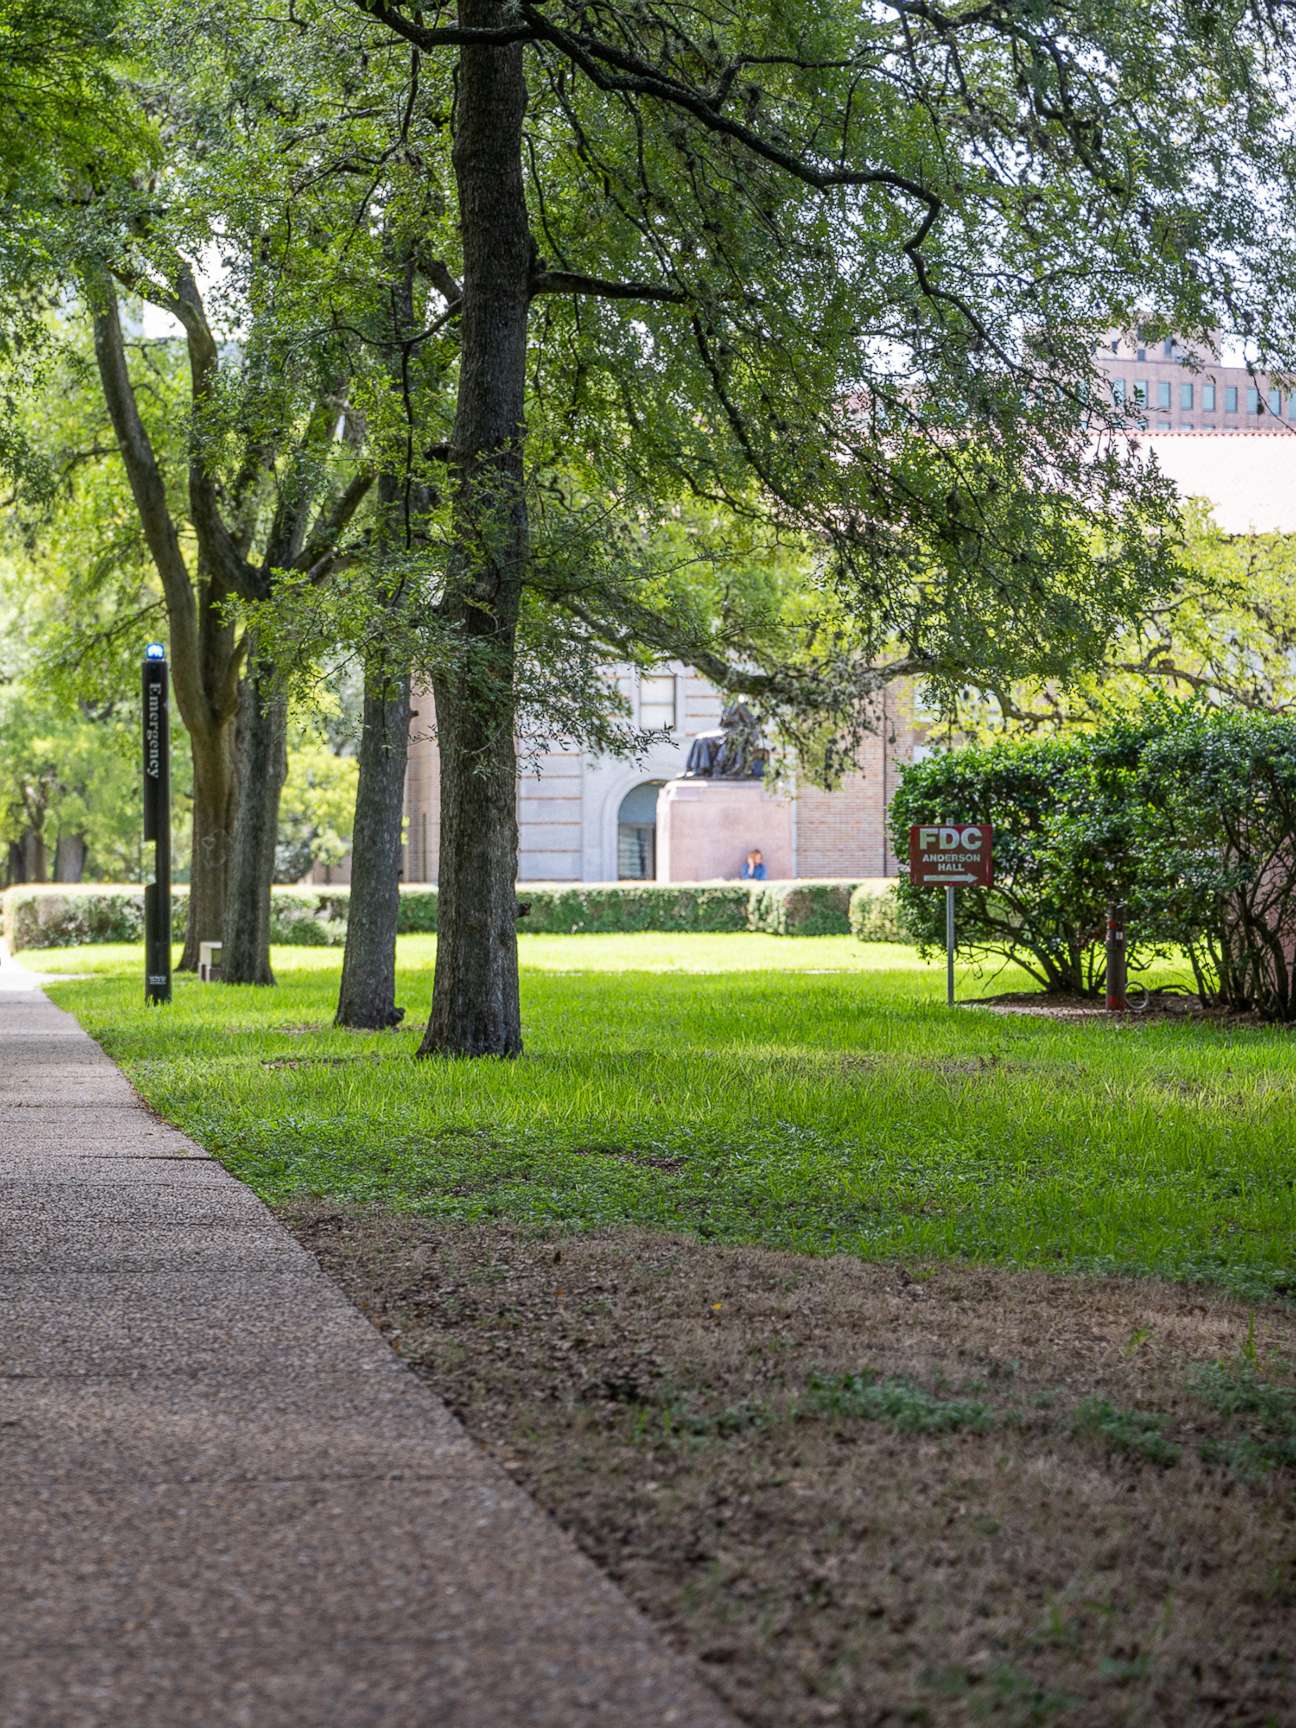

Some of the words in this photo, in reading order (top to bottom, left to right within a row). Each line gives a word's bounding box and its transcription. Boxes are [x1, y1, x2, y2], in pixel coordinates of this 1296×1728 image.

[147, 683, 161, 778] Emergency
[919, 827, 982, 850] FDC
[922, 854, 981, 862] ANDERSON
[938, 863, 965, 871] HALL
